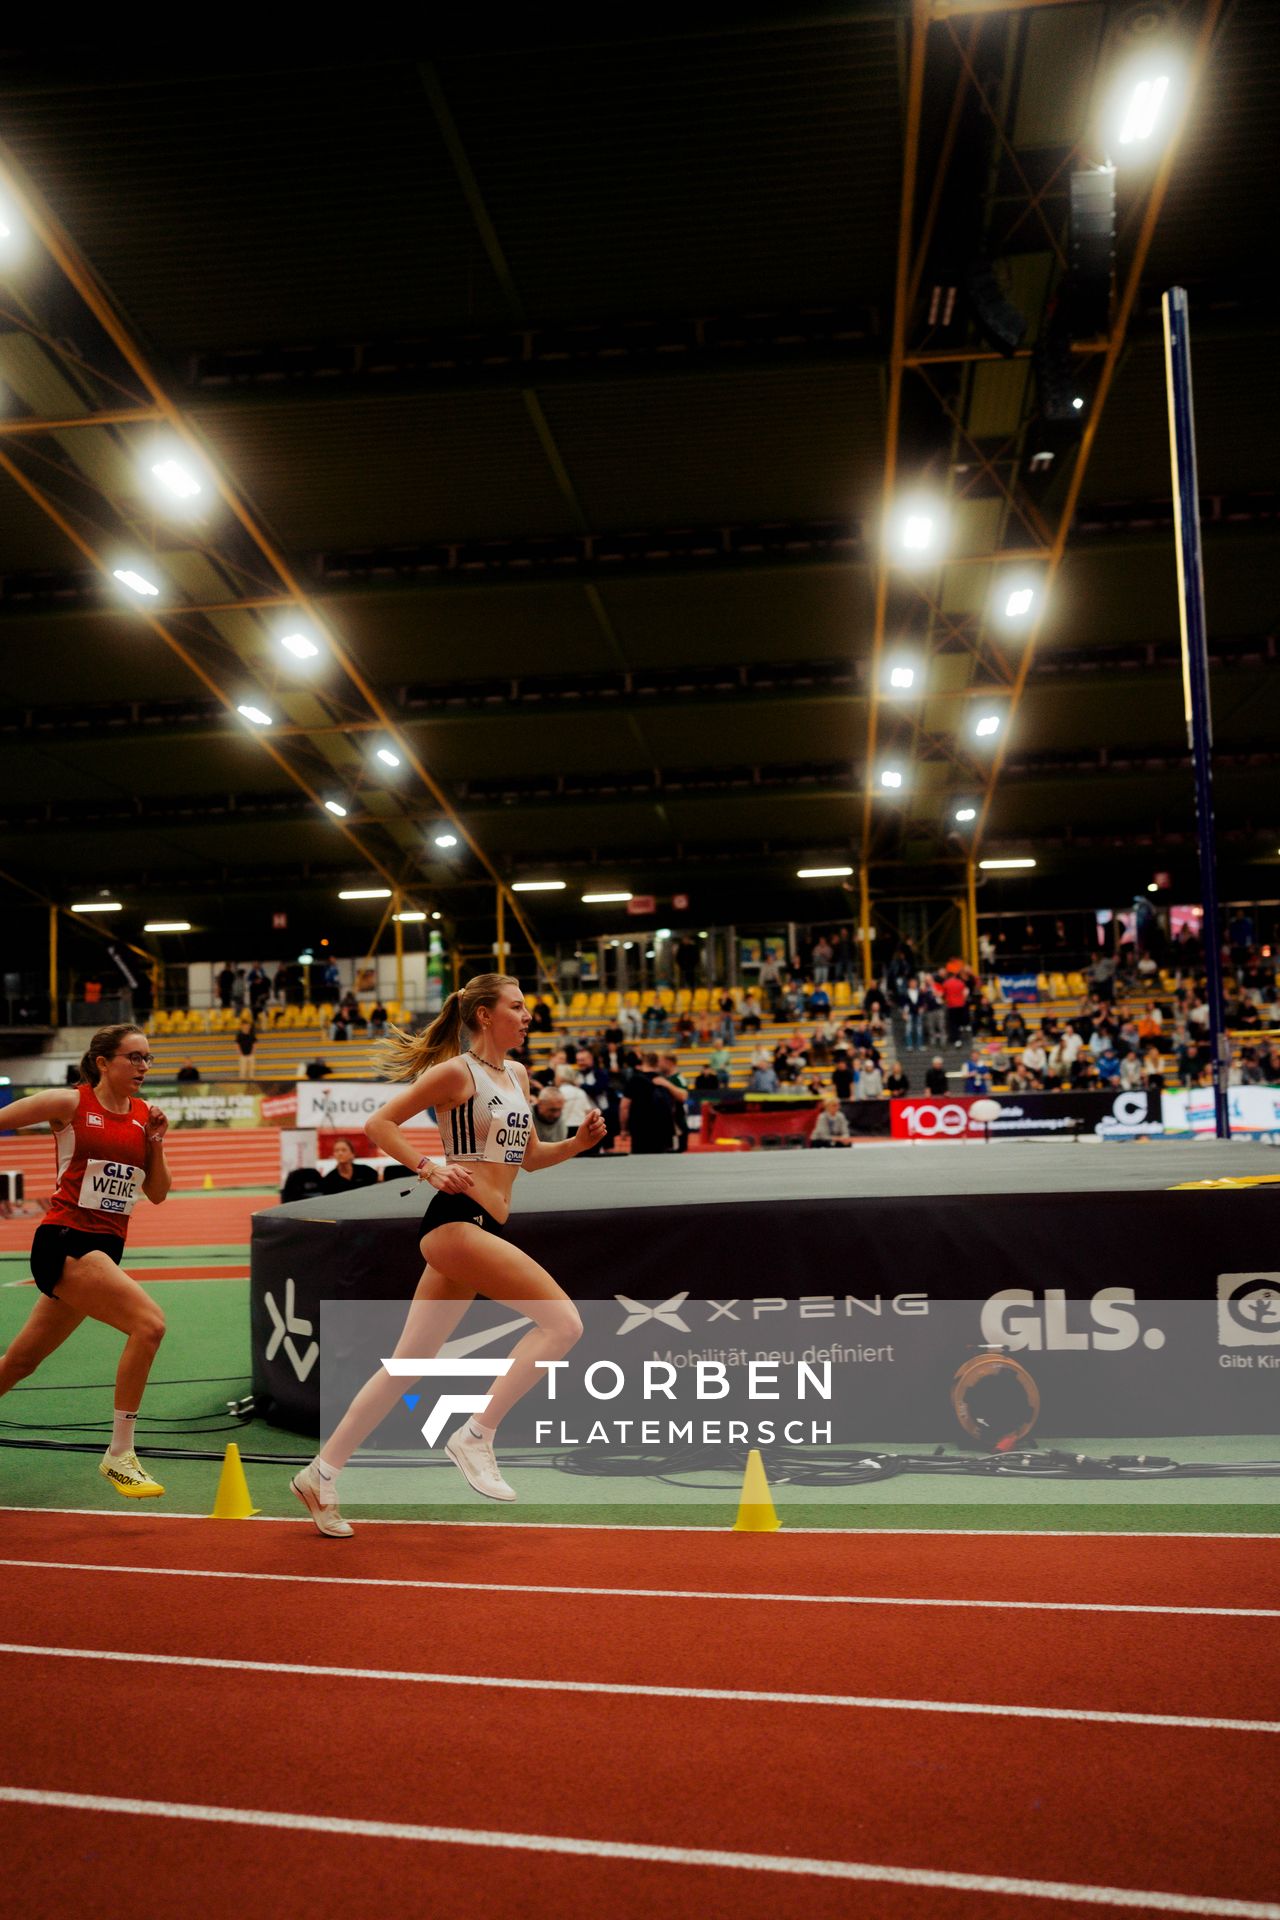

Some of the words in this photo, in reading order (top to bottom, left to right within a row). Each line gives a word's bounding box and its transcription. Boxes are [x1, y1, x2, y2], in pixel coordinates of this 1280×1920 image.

[507, 1112, 529, 1129] GLS
[900, 1105, 967, 1136] 100
[496, 1128, 530, 1147] QUAS
[103, 1162, 135, 1180] GLS
[93, 1176, 136, 1198] WEIKE
[706, 1293, 929, 1322] XPENG
[652, 1347, 748, 1369] Mobilität
[755, 1349, 794, 1366] neu
[800, 1343, 895, 1366] definiert
[1219, 1354, 1254, 1368] Gibt
[107, 1468, 142, 1486] BROOKS
